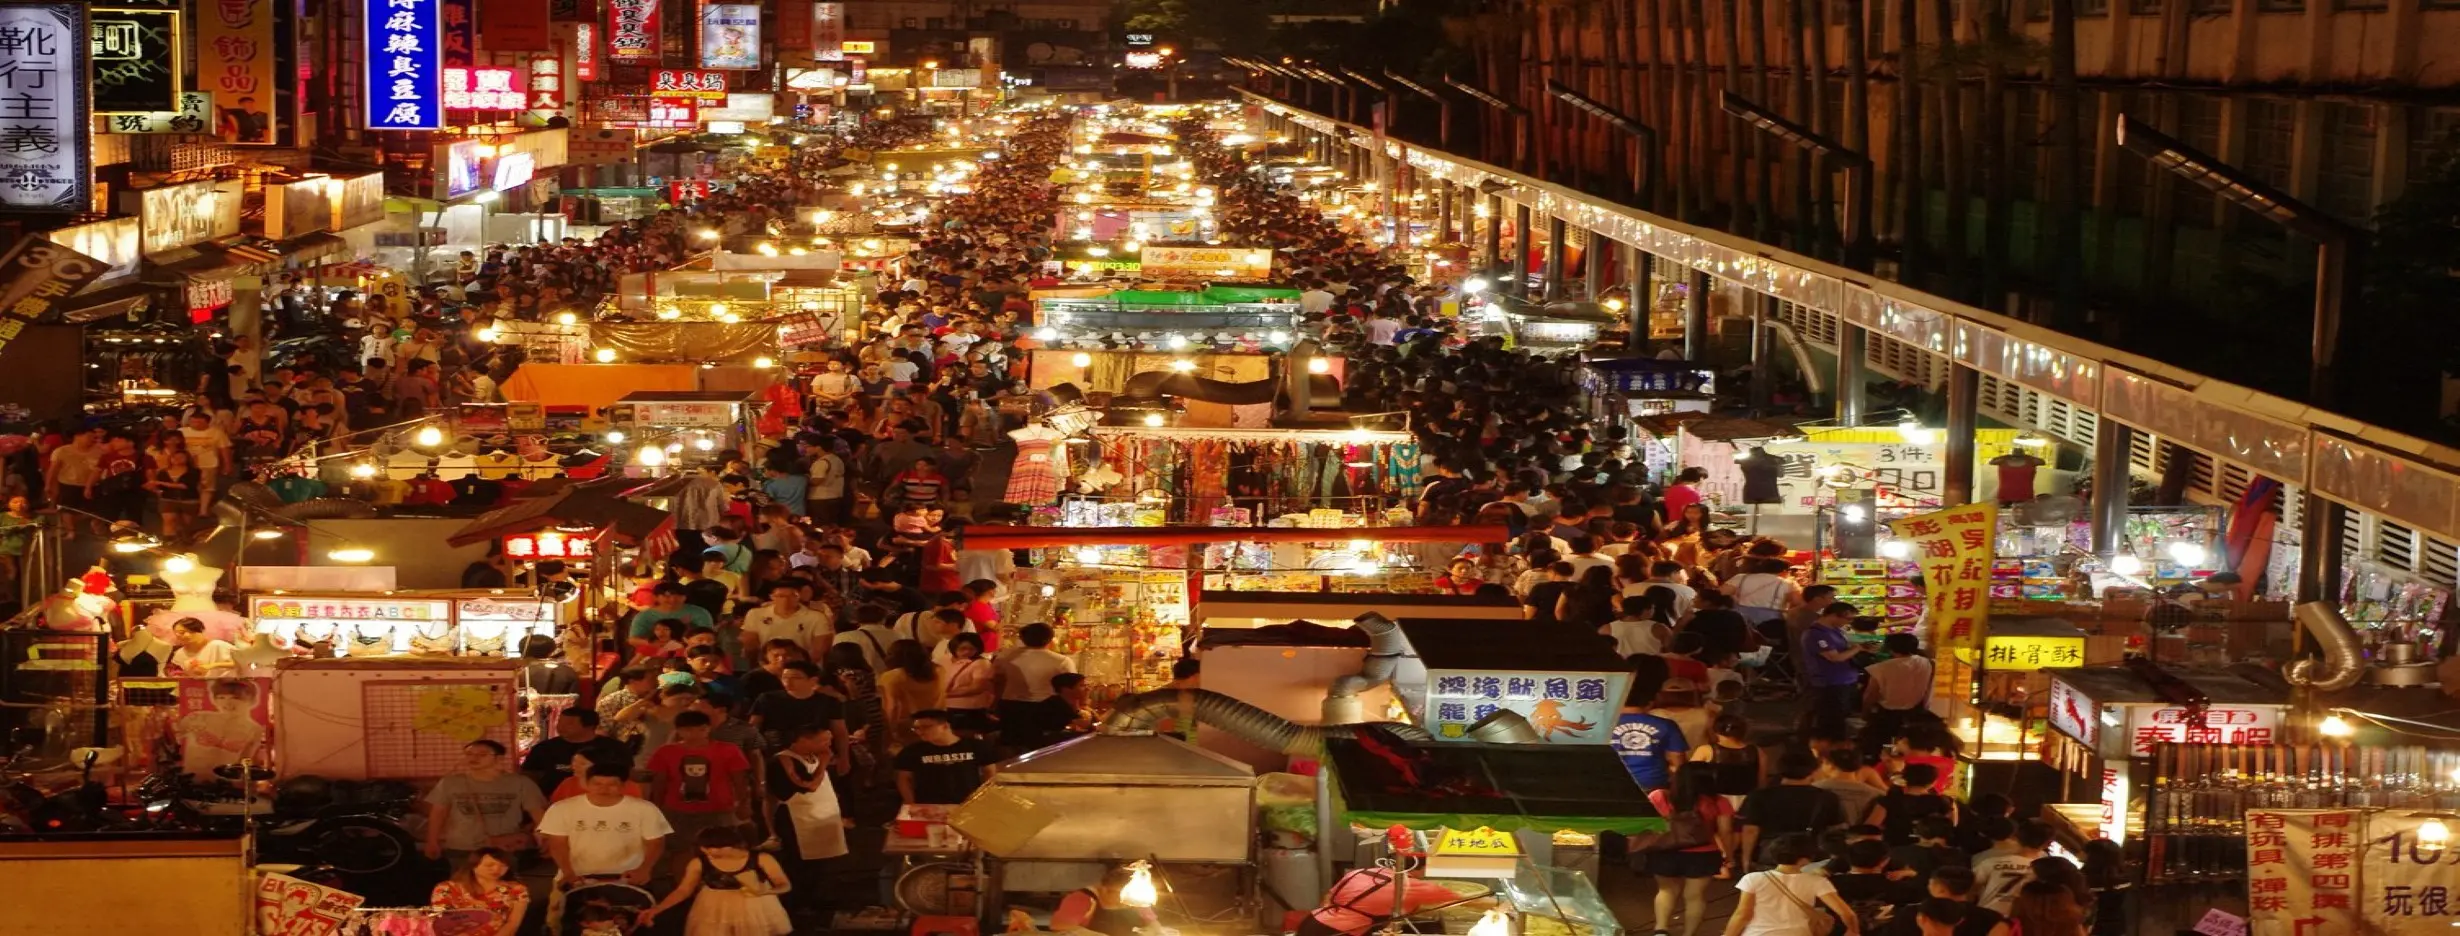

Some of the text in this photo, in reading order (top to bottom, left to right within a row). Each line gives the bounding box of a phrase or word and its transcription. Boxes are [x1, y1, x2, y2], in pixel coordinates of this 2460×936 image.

[0, 27, 59, 153] 靴行主義
[657, 71, 724, 90] 臭臭鍋
[1988, 644, 2083, 664] 排骨酥
[2383, 886, 2460, 916] 玩很
